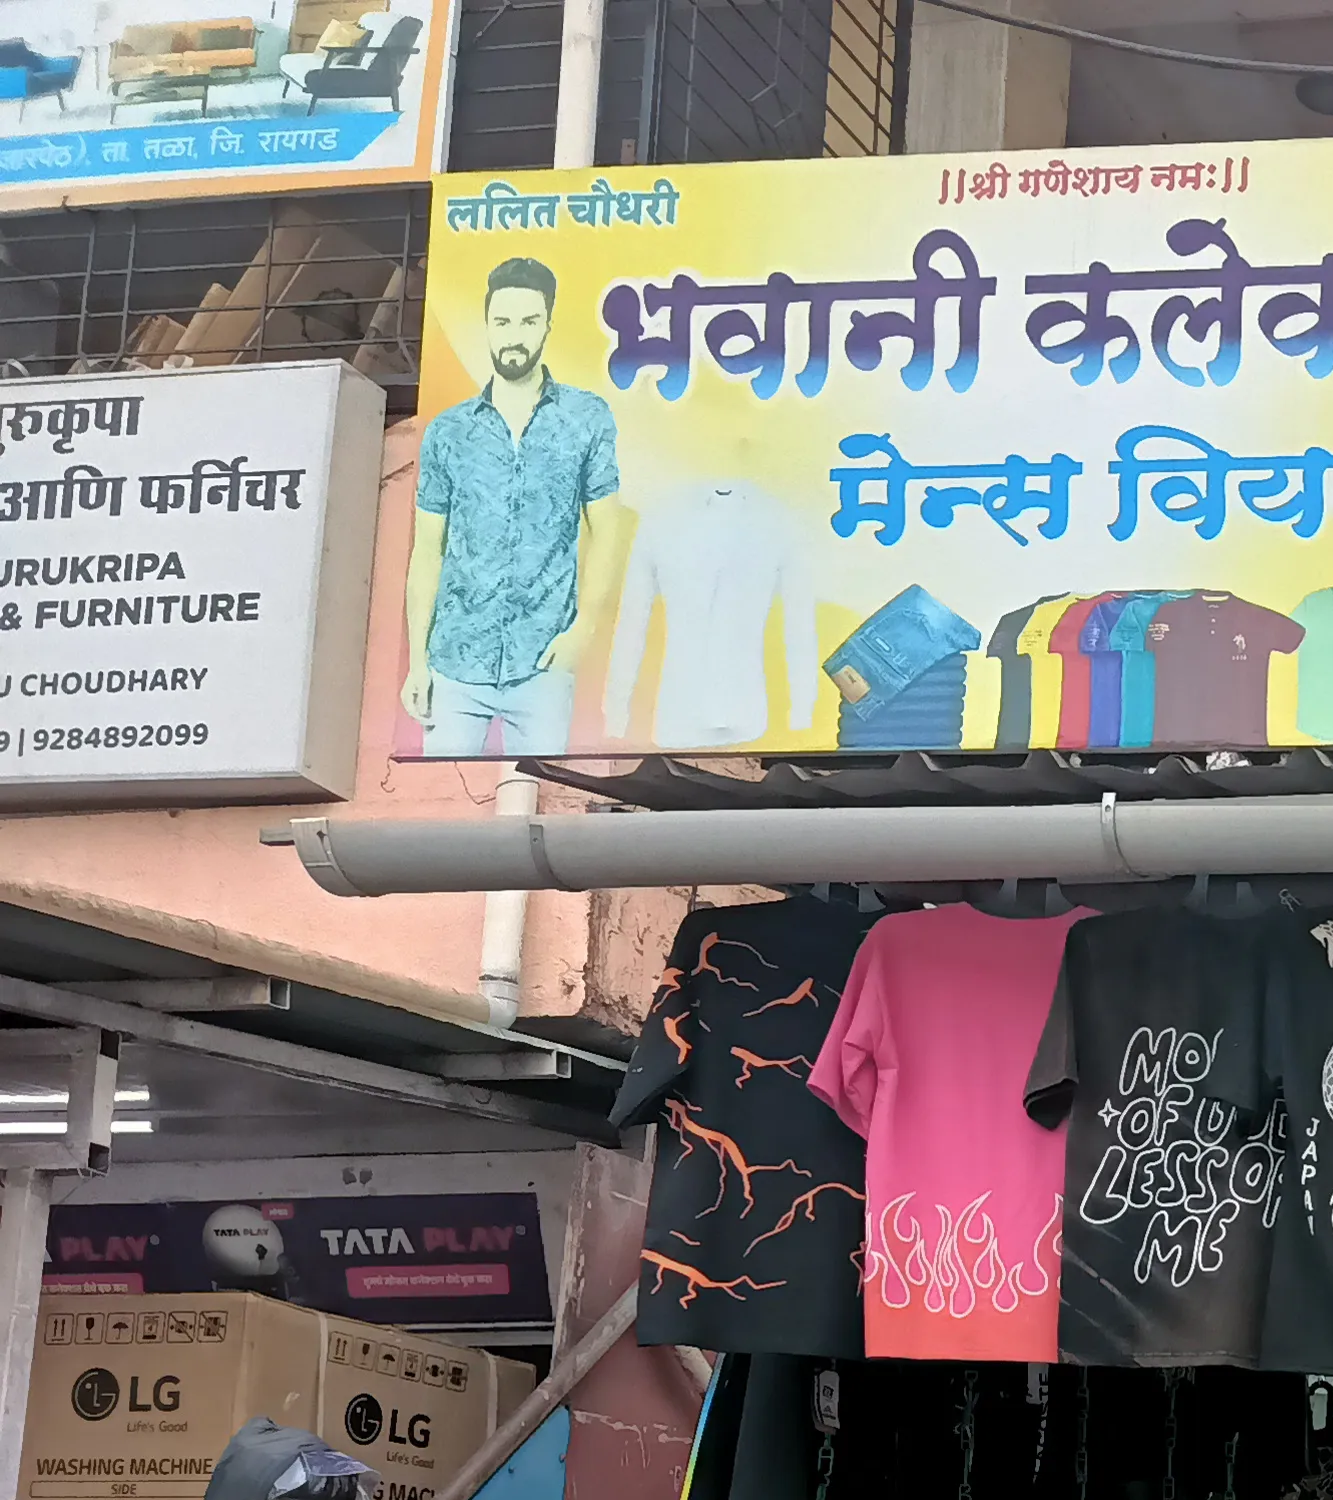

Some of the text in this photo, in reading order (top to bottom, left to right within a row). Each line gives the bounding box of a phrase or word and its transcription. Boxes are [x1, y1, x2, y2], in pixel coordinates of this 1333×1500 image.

[258, 128, 341, 153] रायगड
[1018, 156, 1142, 199] गणेशाय
[446, 177, 680, 233] ललित चौधरी
[601, 229, 997, 402] भवानी
[139, 456, 307, 514] फर्निचर
[829, 432, 1083, 546] मेन्स
[34, 592, 262, 630] FURNITURE
[20, 668, 209, 697] CHOUDHARY
[33, 722, 210, 752] 9284892099
[1117, 1084, 1194, 1150] OF
[1079, 1140, 1229, 1224] LESS
[59, 1235, 149, 1262] PLAY
[212, 1228, 240, 1237] TATA
[320, 1225, 514, 1256] TATA PLAY
[1133, 1199, 1240, 1287] ME
[129, 1375, 181, 1412] LG
[159, 1421, 188, 1433] Good
[388, 1408, 432, 1449] LG
[36, 1458, 214, 1476] WASHING MACHINE
[411, 1452, 435, 1469] Good
[111, 1483, 137, 1496] SIDE
